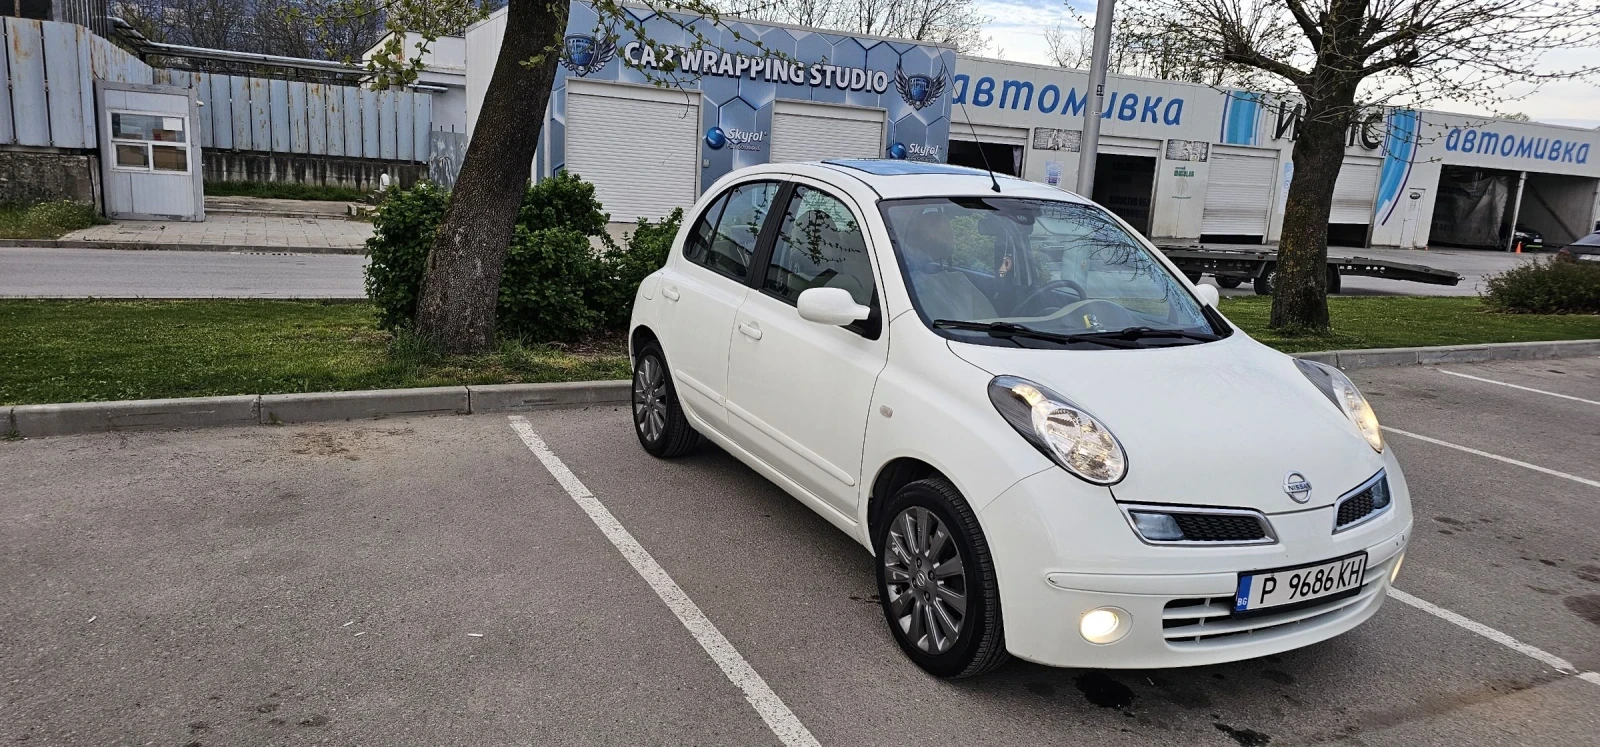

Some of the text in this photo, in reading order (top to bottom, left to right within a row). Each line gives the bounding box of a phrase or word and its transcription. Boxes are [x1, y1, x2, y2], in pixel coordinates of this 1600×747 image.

[680, 48, 805, 84] WRAPPING
[809, 64, 889, 93] STUDIO
[729, 128, 763, 143] Skyfol
[1445, 128, 1590, 164] автомивка
[1287, 482, 1311, 491] NISSAN
[1260, 576, 1277, 604] P
[1237, 598, 1248, 606] BG
